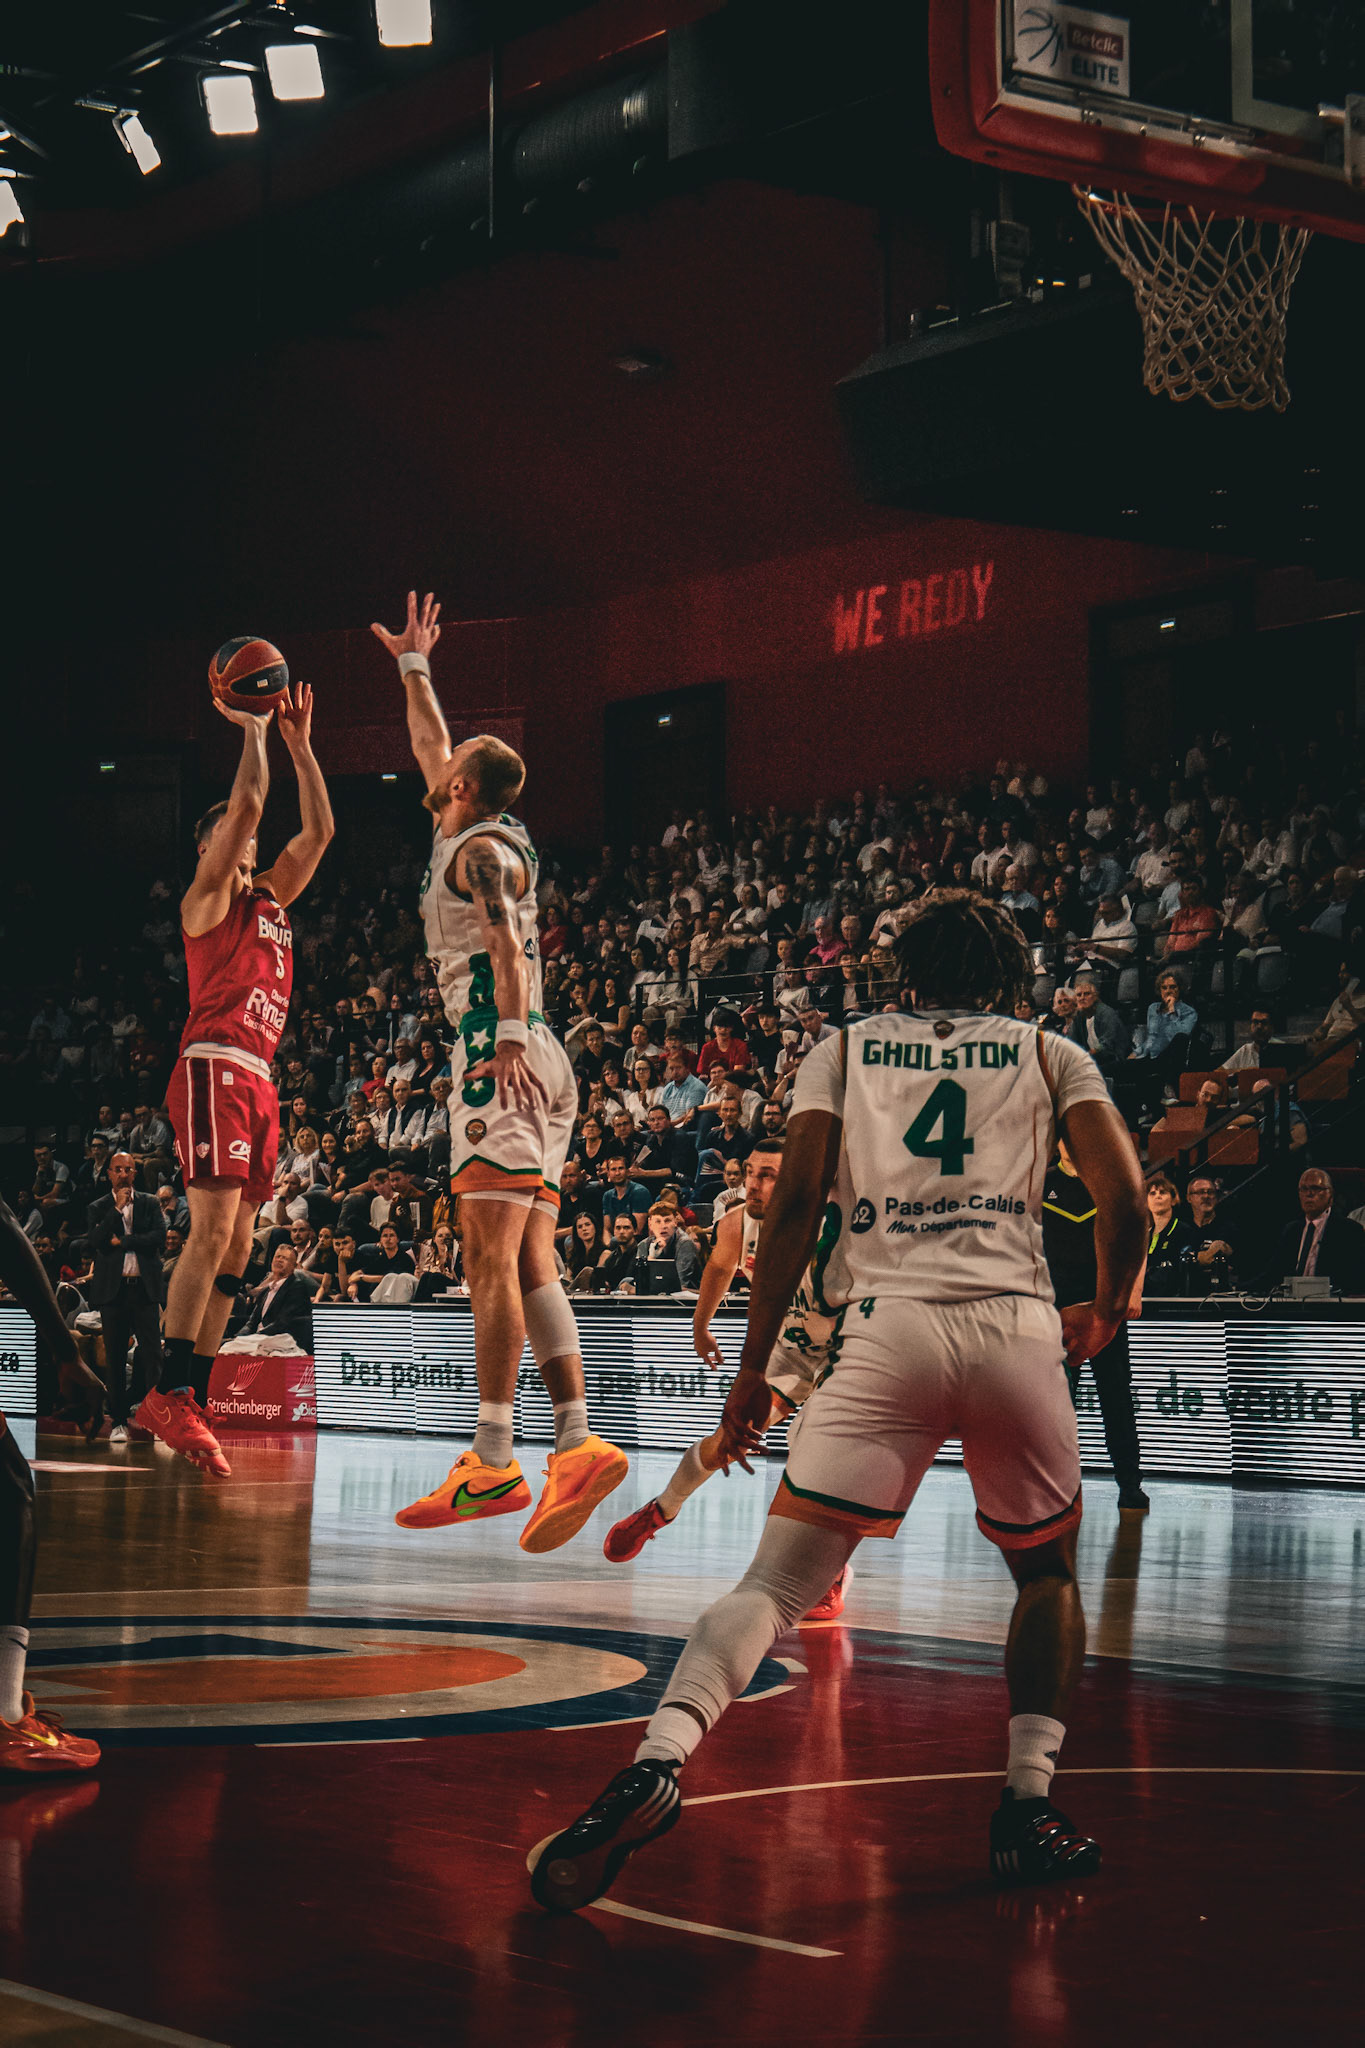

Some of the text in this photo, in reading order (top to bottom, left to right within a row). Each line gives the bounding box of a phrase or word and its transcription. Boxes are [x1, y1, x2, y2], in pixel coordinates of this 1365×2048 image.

[832, 584, 888, 654] WE
[862, 1039, 1019, 1071] GHOLSTON
[903, 1078, 975, 1176] 4
[886, 1220, 918, 1234] Mon
[859, 1297, 876, 1319] 4
[341, 1351, 383, 1387] Des
[1156, 1368, 1204, 1418] de
